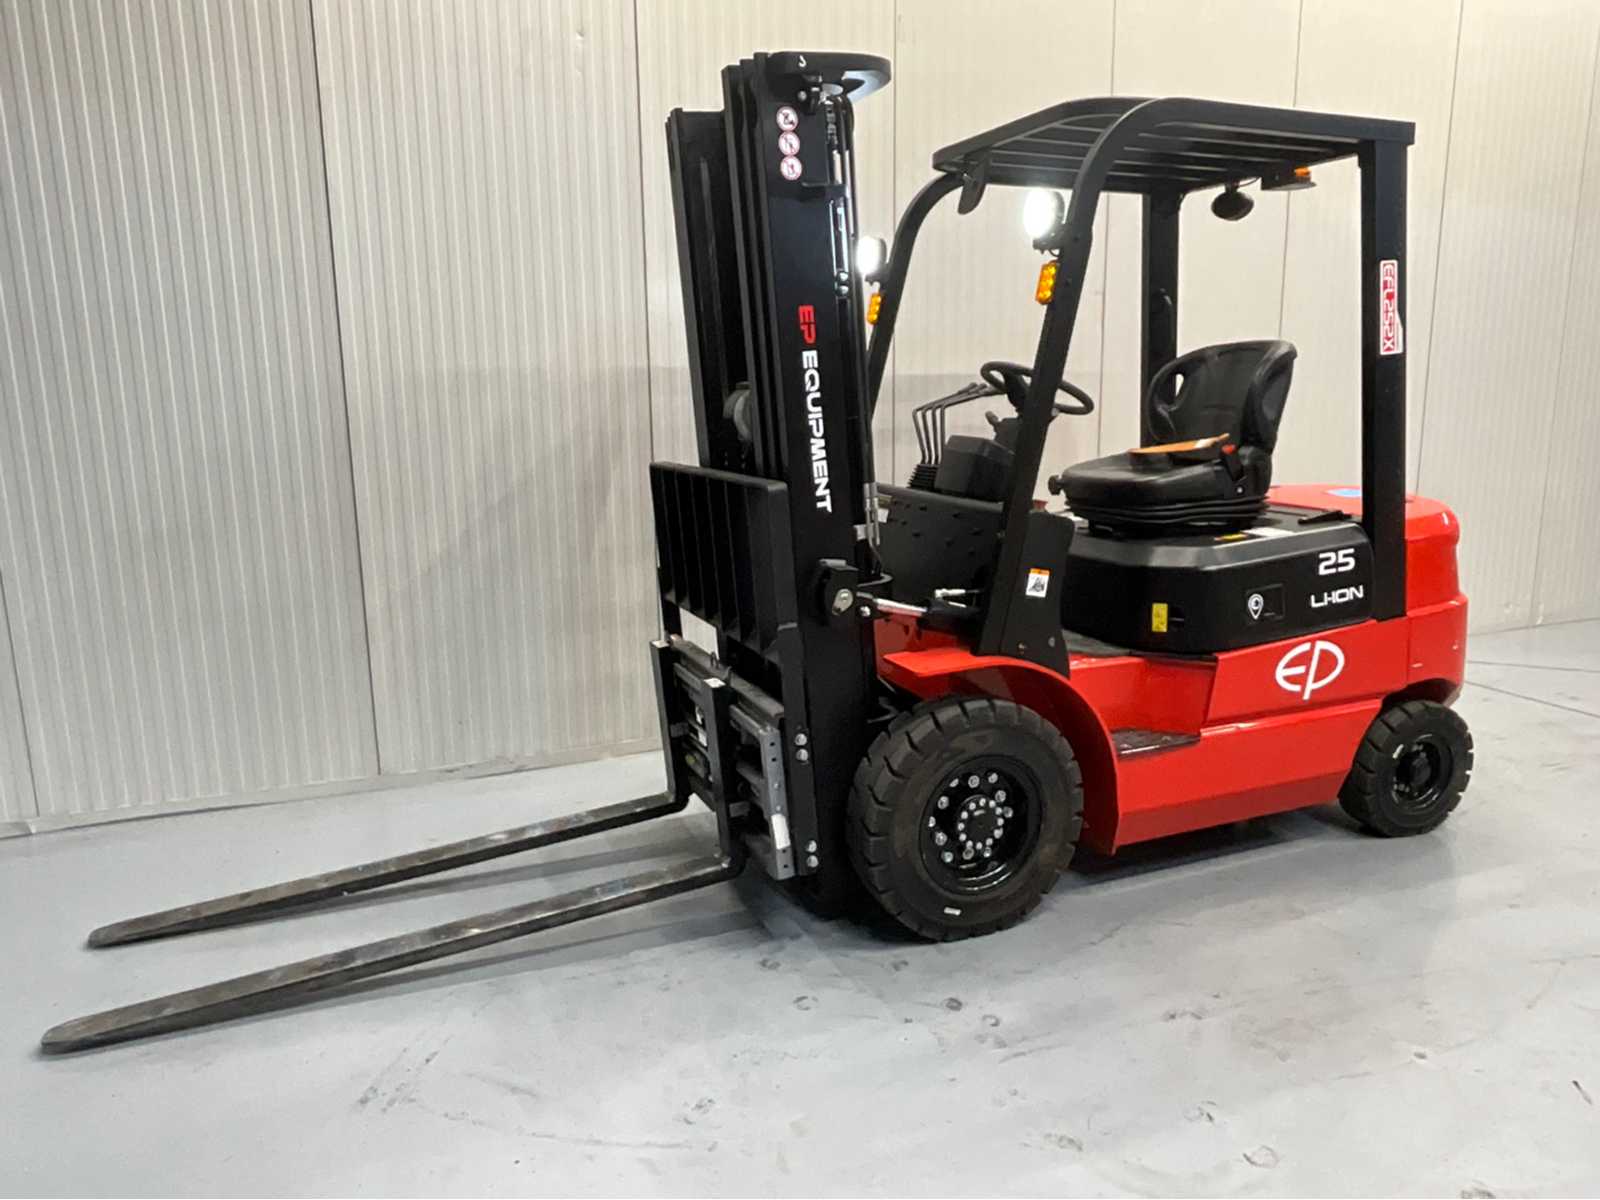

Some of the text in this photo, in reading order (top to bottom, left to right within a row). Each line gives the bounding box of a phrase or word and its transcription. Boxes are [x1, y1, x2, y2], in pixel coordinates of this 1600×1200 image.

[798, 304, 833, 512] EP EQUIPMENT
[1318, 547, 1355, 575] 25
[1275, 640, 1345, 700] EP
